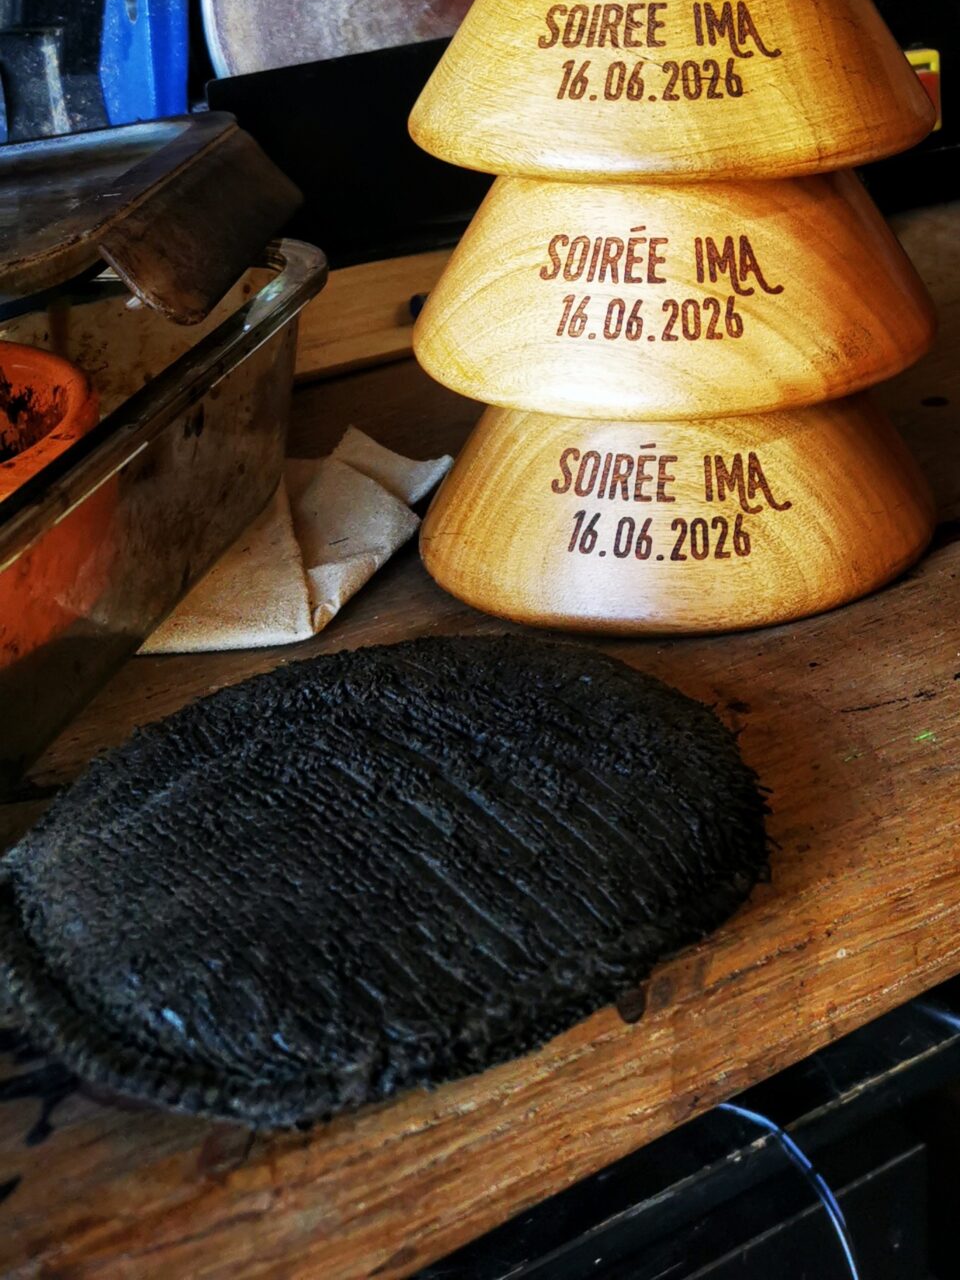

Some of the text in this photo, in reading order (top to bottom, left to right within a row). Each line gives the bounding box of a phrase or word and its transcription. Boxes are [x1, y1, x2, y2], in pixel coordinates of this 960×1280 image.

[695, 1, 781, 58] IMA
[556, 59, 743, 101] 16.06.2026
[540, 225, 784, 295] SOIRÉE IMA
[556, 294, 743, 342] 16.06.2026
[551, 444, 792, 513] SOIRÉE IMA
[568, 511, 750, 561] 16.06.2026
